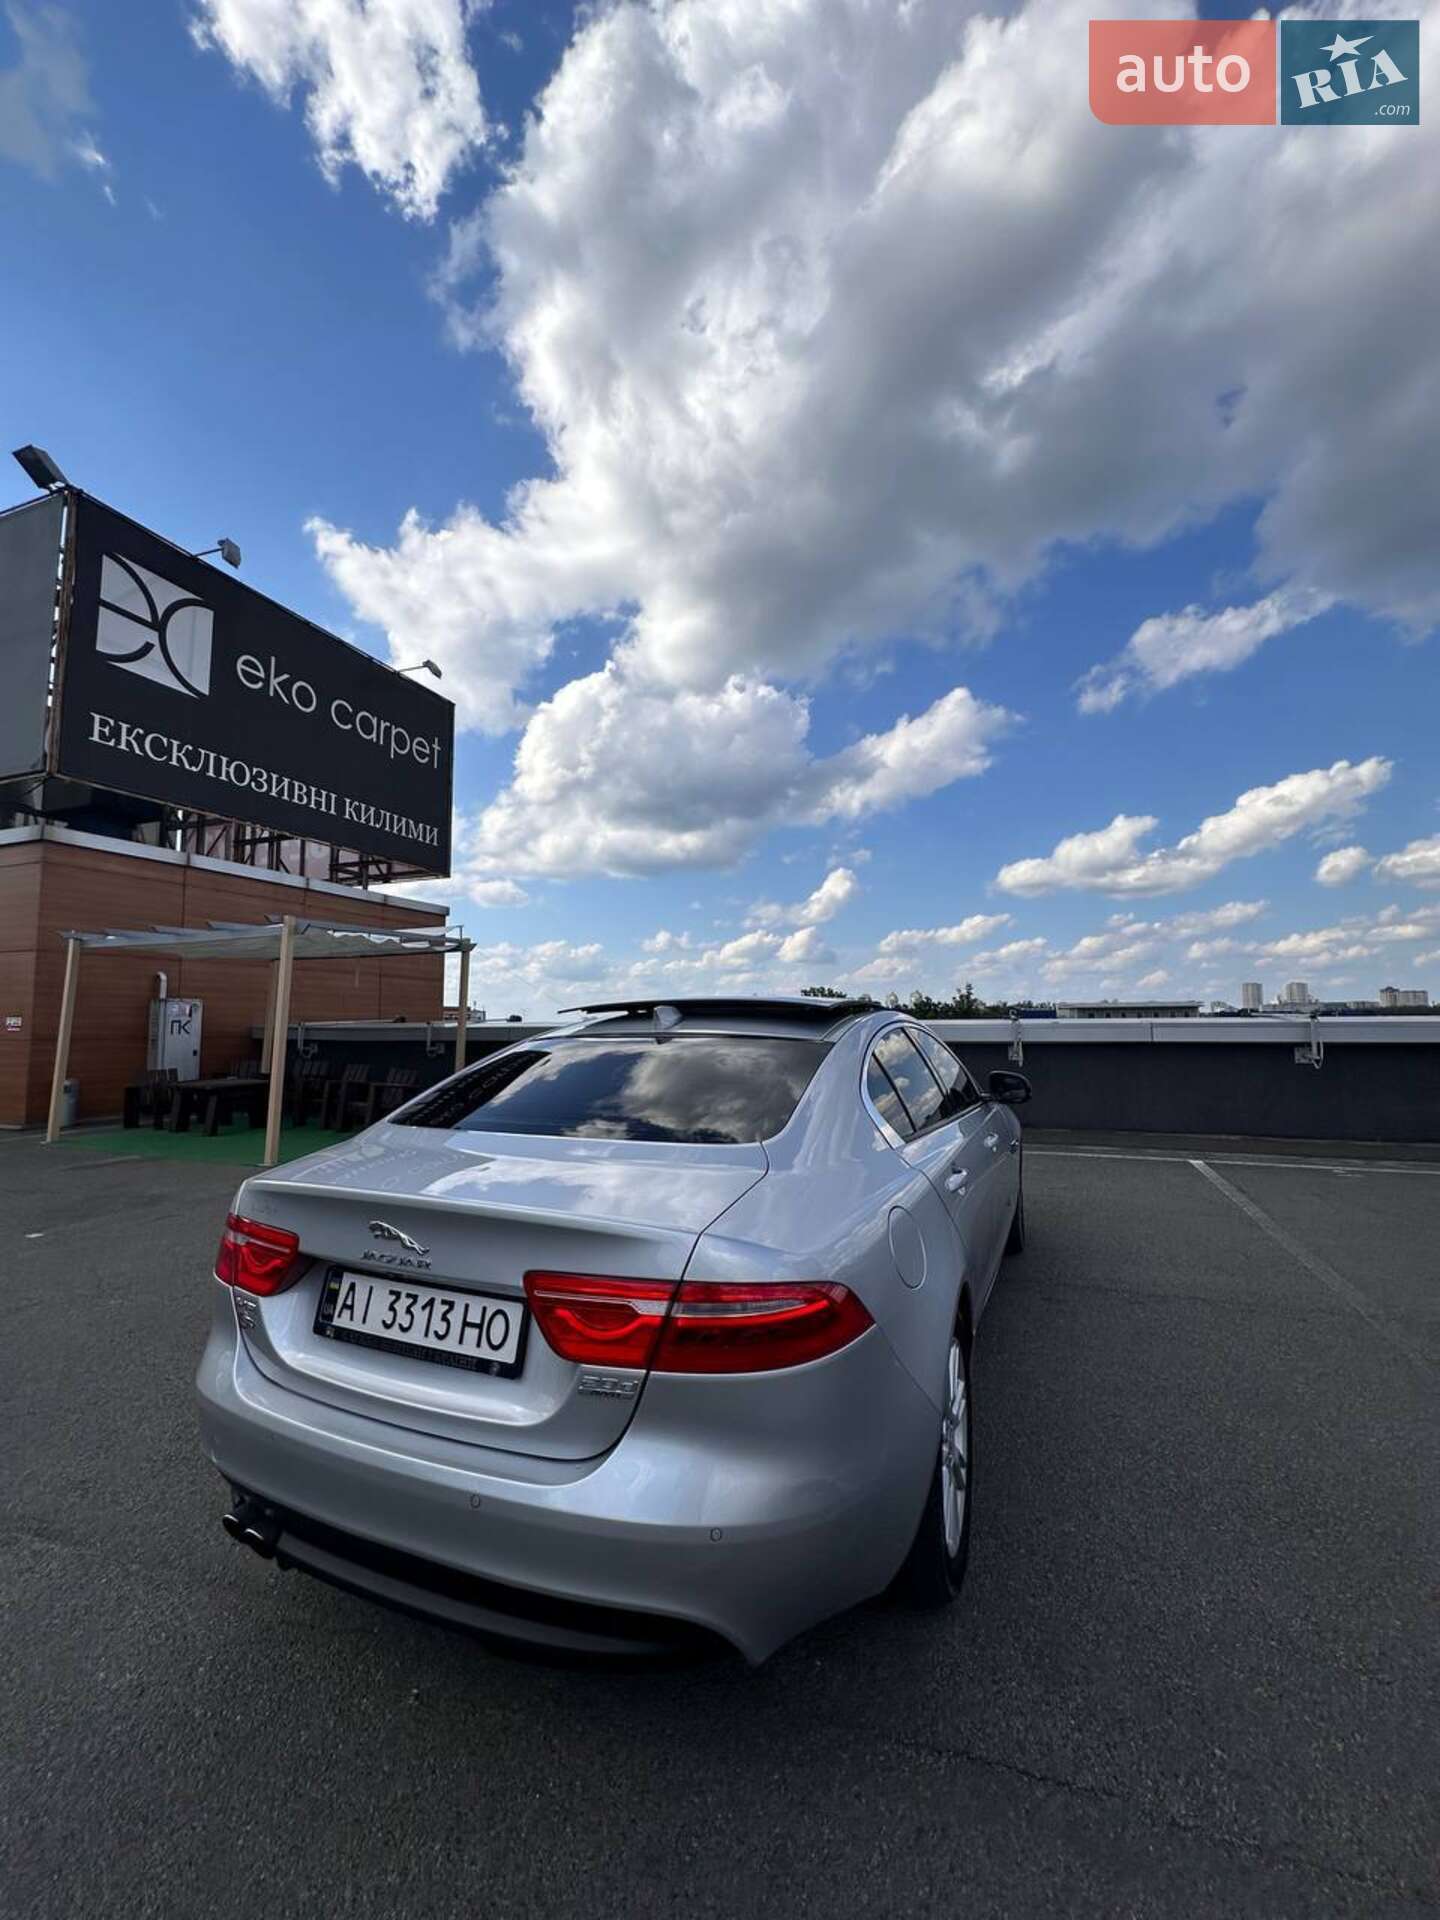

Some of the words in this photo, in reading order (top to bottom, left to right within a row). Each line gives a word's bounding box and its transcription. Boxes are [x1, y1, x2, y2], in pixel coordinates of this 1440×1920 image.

[236, 655, 316, 713] eko
[331, 699, 441, 768] carpet
[88, 712, 337, 815] ЕКСКЛЮЗИВНІ
[344, 797, 439, 846] КИЛИМИ
[337, 1281, 373, 1325] AI
[381, 1289, 455, 1341] 3313
[459, 1302, 510, 1351] HO
